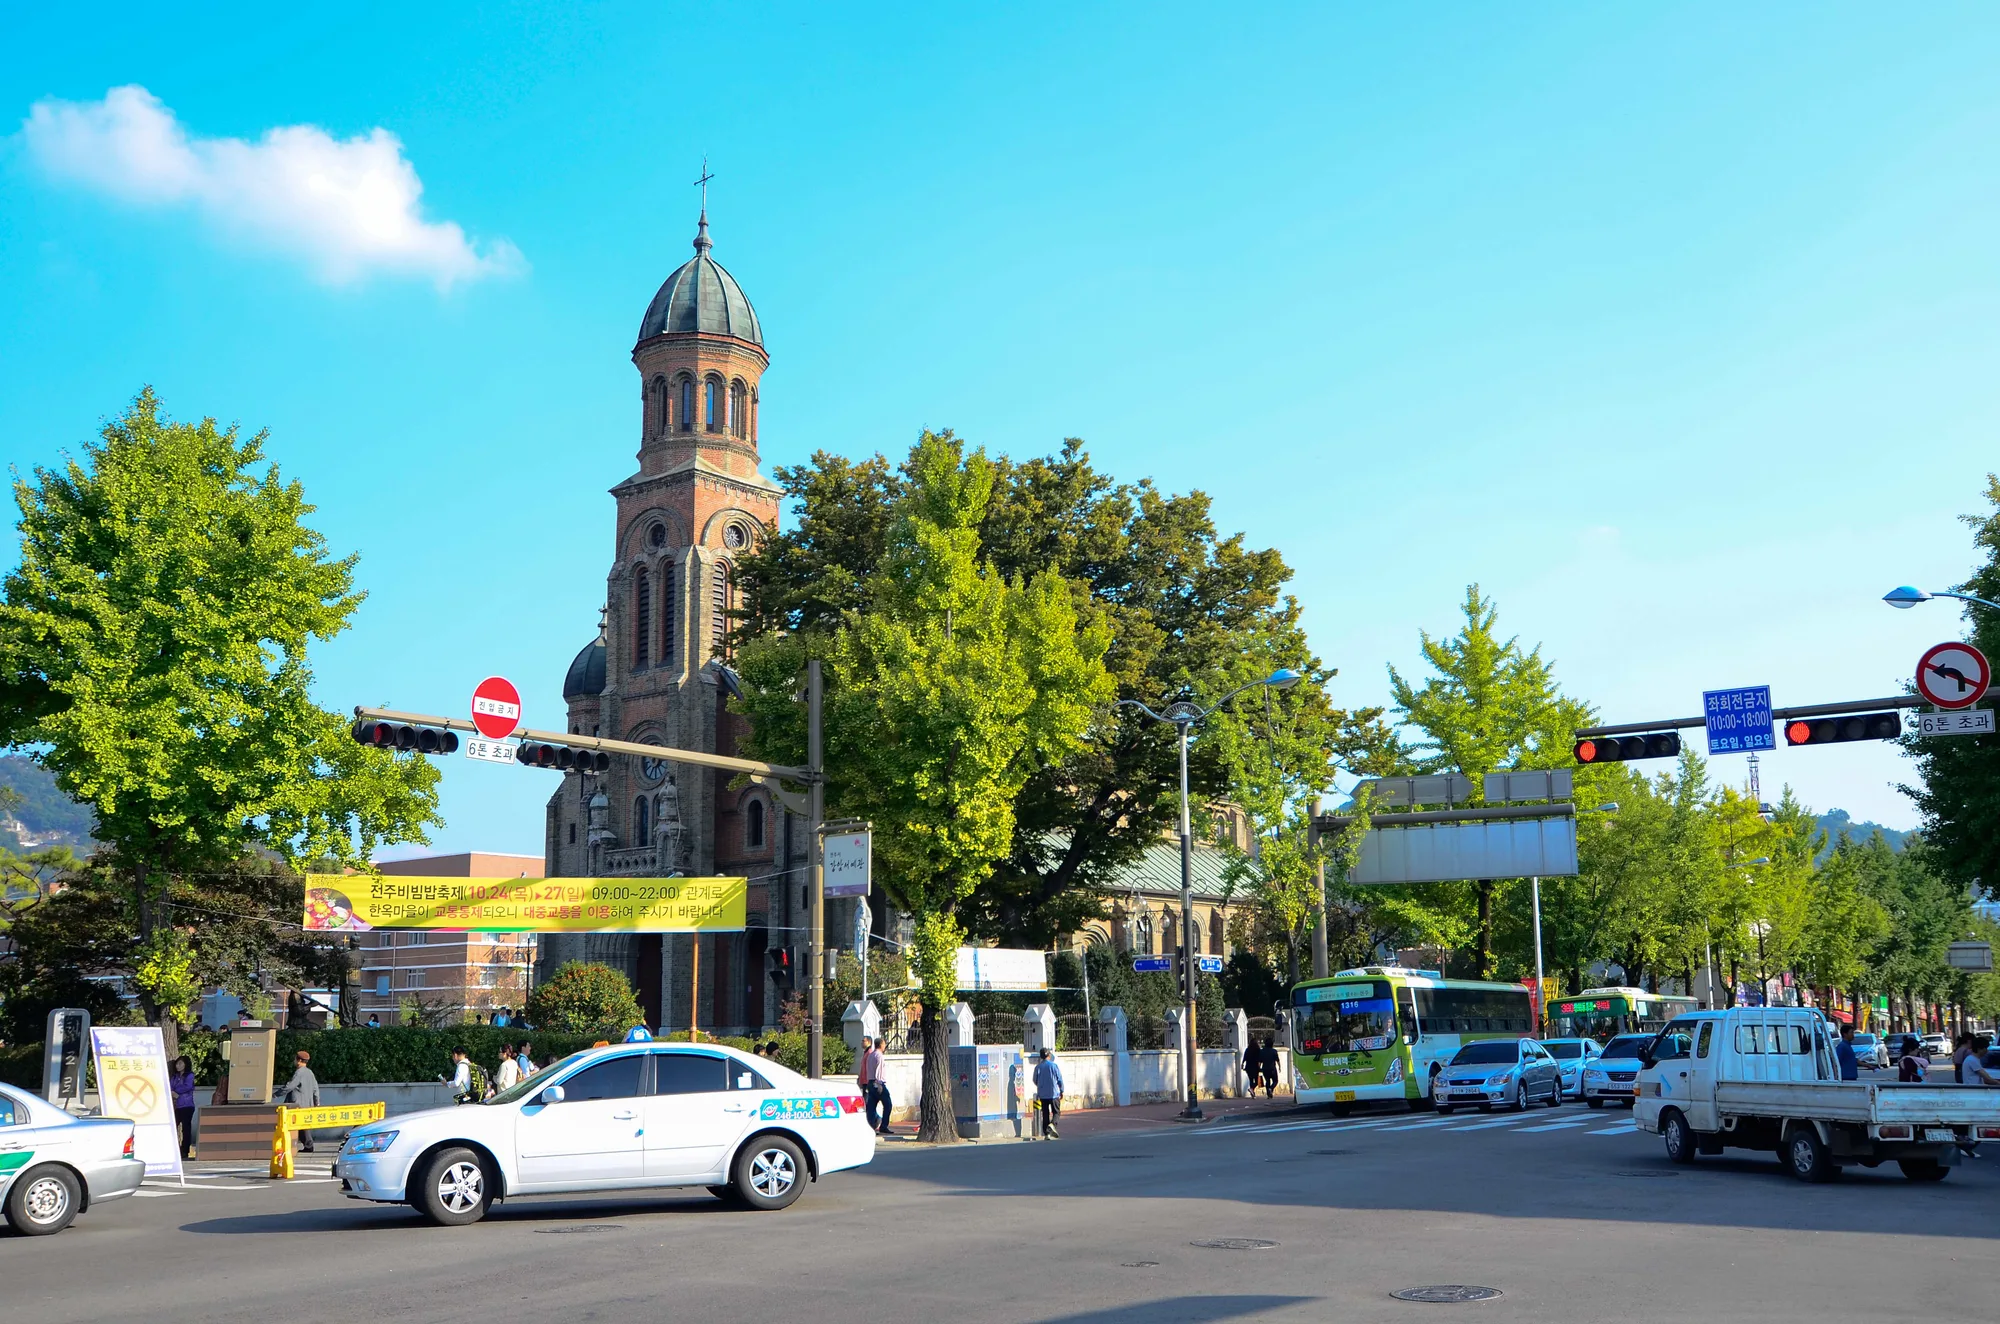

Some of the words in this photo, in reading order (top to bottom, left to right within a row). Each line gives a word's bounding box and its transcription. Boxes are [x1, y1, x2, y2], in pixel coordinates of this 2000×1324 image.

[479, 701, 514, 715] 진입금지
[1708, 690, 1768, 712] 좌회전금지
[1709, 710, 1770, 731] (10:00~18:00)
[1923, 716, 1950, 732] 6톤
[1958, 714, 1989, 729] 초과
[1710, 736, 1743, 750] 토요일,
[1743, 733, 1773, 748] 일요일
[468, 742, 487, 757] 6톤
[492, 745, 513, 760] 초과
[592, 886, 680, 902] 09:00~22:00)
[685, 886, 723, 900] 관계로
[369, 904, 429, 918] 한옥마을이
[434, 905, 518, 919] 교통통제되오니
[523, 905, 582, 919] 대중교통을
[587, 906, 633, 919] 이용하여
[638, 906, 673, 919] 주시기
[678, 905, 723, 919] 바랍니다
[1341, 1001, 1359, 1009] 1316
